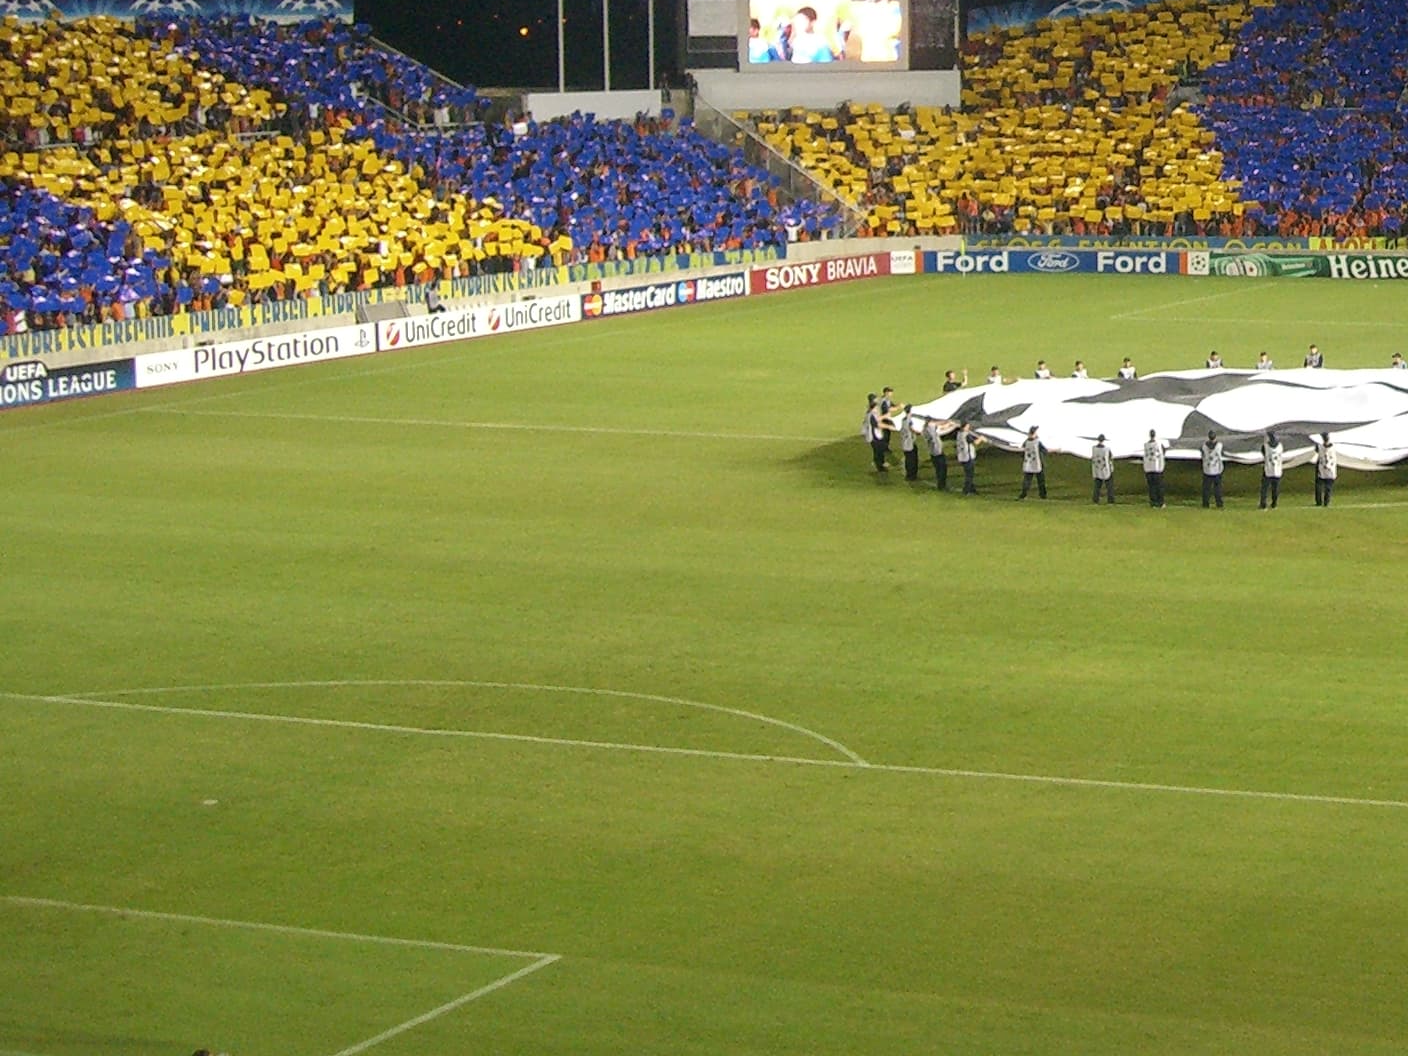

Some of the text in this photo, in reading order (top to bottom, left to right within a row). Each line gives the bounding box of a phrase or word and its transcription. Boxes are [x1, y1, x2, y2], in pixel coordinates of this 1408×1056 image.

[765, 262, 823, 290] SONY
[827, 255, 878, 281] BRAVIA
[936, 251, 1008, 272] Ford
[1037, 255, 1070, 268] Ford
[1097, 251, 1167, 273] Ford
[603, 276, 744, 315] MasterCard Maestro
[404, 313, 477, 343] UniCredit
[505, 299, 571, 328] UniCredit
[147, 335, 339, 375] SONY PlayStation
[6, 363, 48, 381] UEFA
[48, 369, 117, 398] LEAGUE
